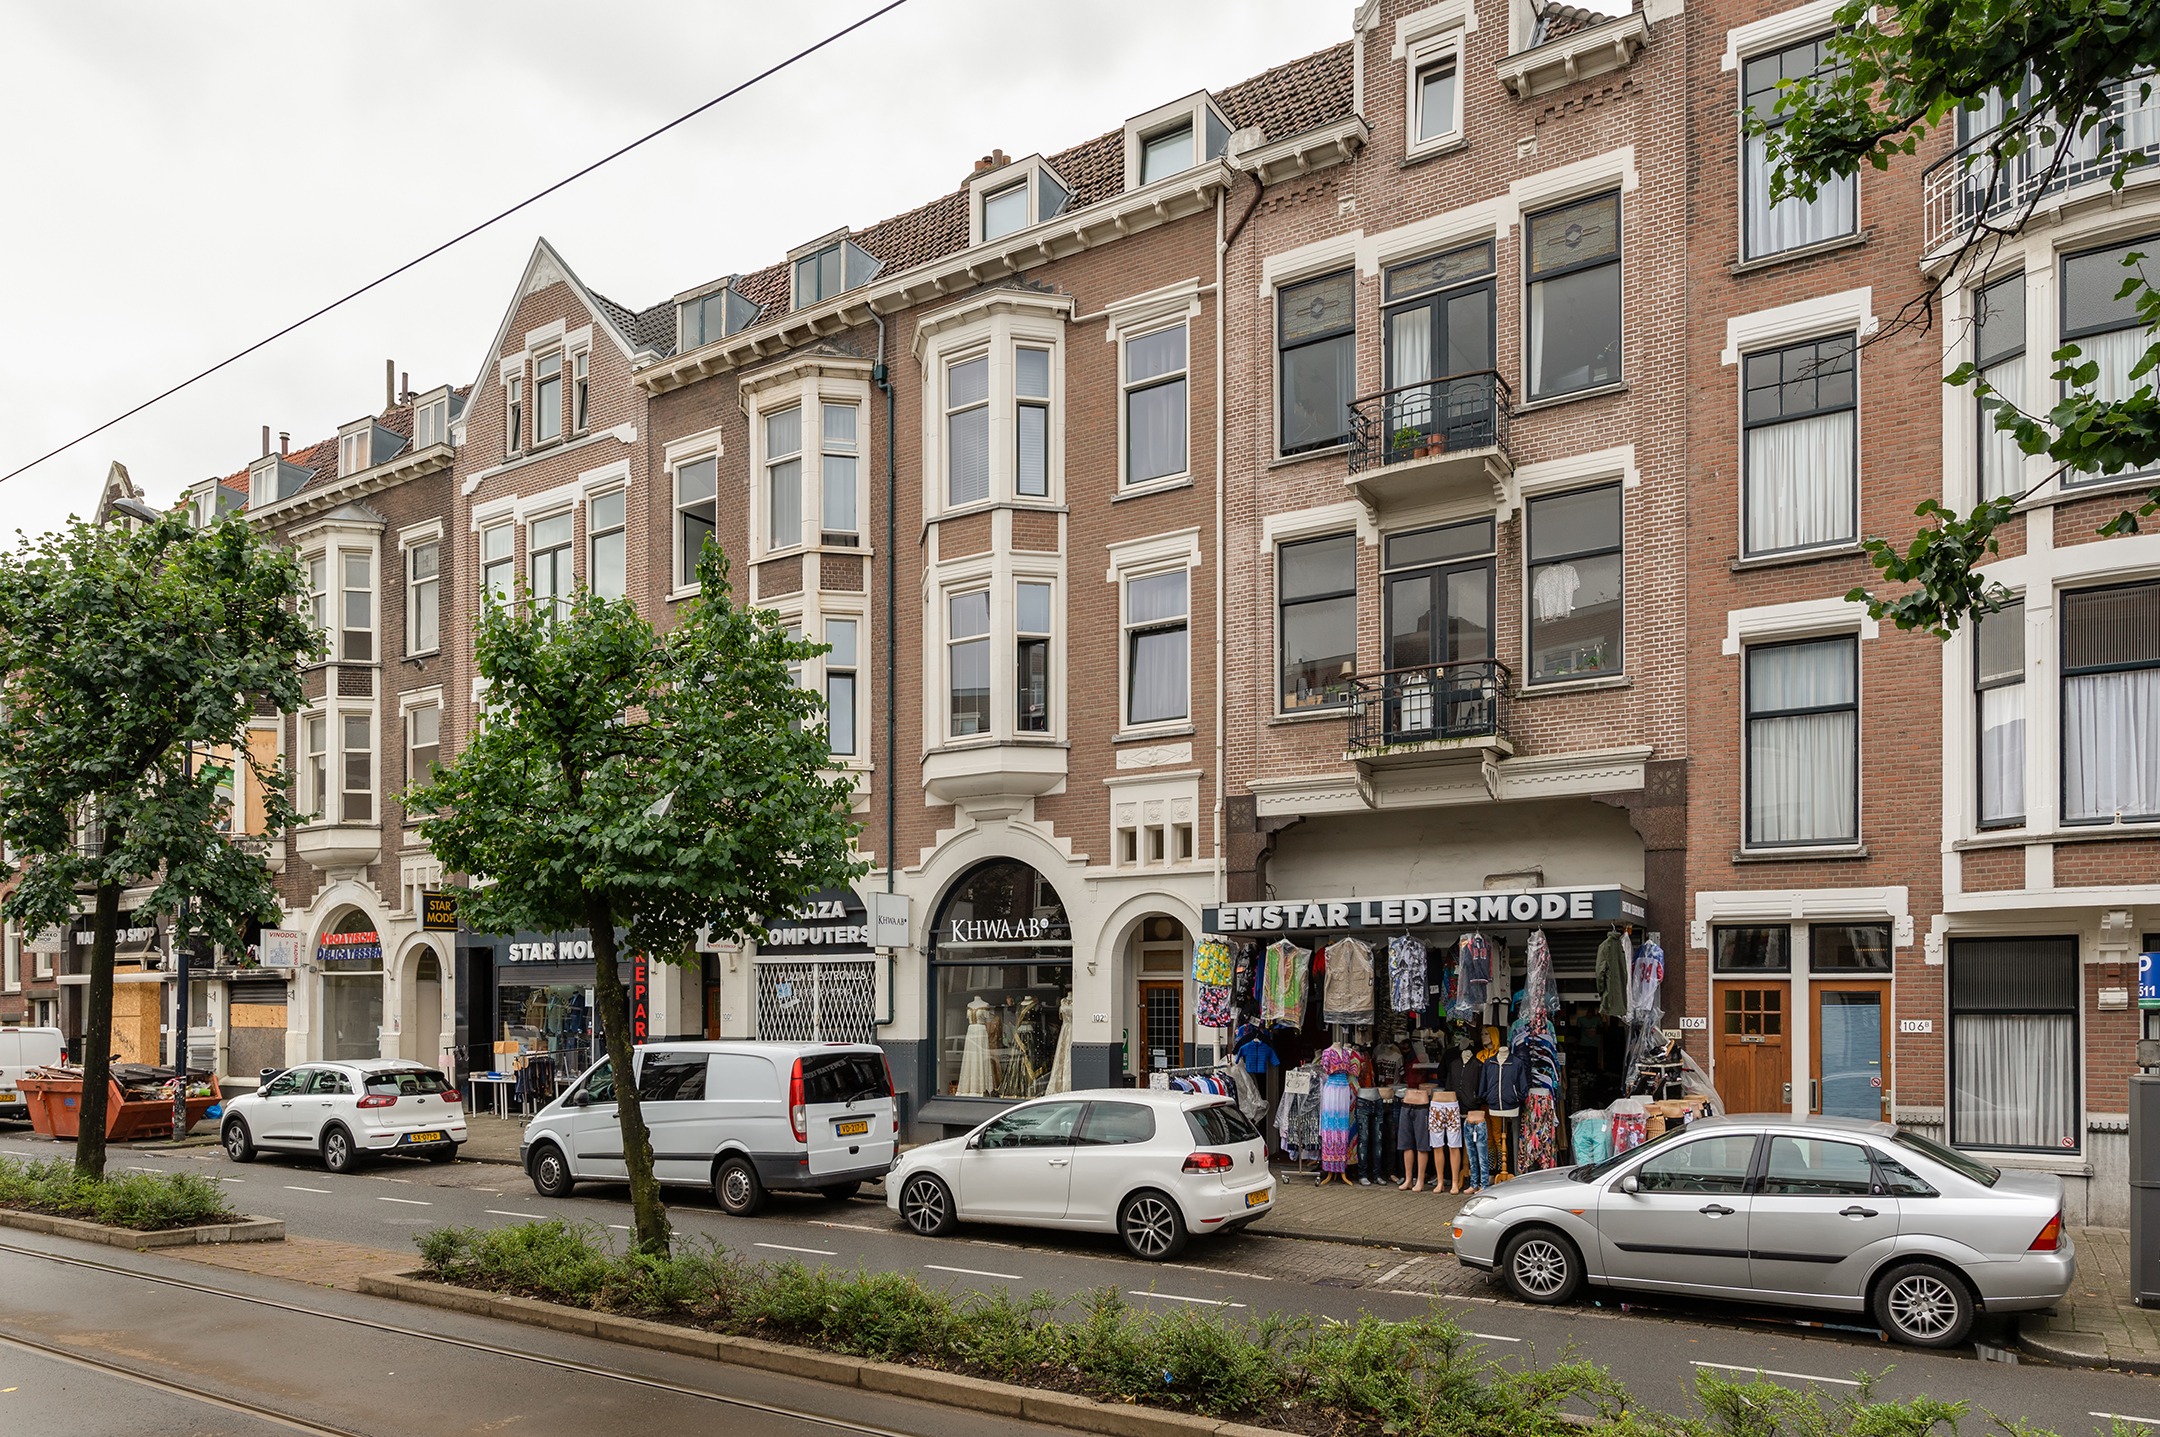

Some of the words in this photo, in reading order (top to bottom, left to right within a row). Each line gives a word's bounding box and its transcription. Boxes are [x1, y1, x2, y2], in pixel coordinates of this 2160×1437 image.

[430, 901, 451, 910] STAR
[1217, 902, 1350, 931] EMSTAR
[1361, 892, 1594, 926] LEDERMODE
[427, 913, 455, 923] MODE
[878, 915, 905, 926] KHWAAB
[127, 927, 155, 942] SHOP
[951, 917, 1040, 942] KHWAAB
[321, 931, 378, 945] KROATISCHE
[317, 947, 383, 960] DELICATESSEN
[509, 943, 556, 961] STAR
